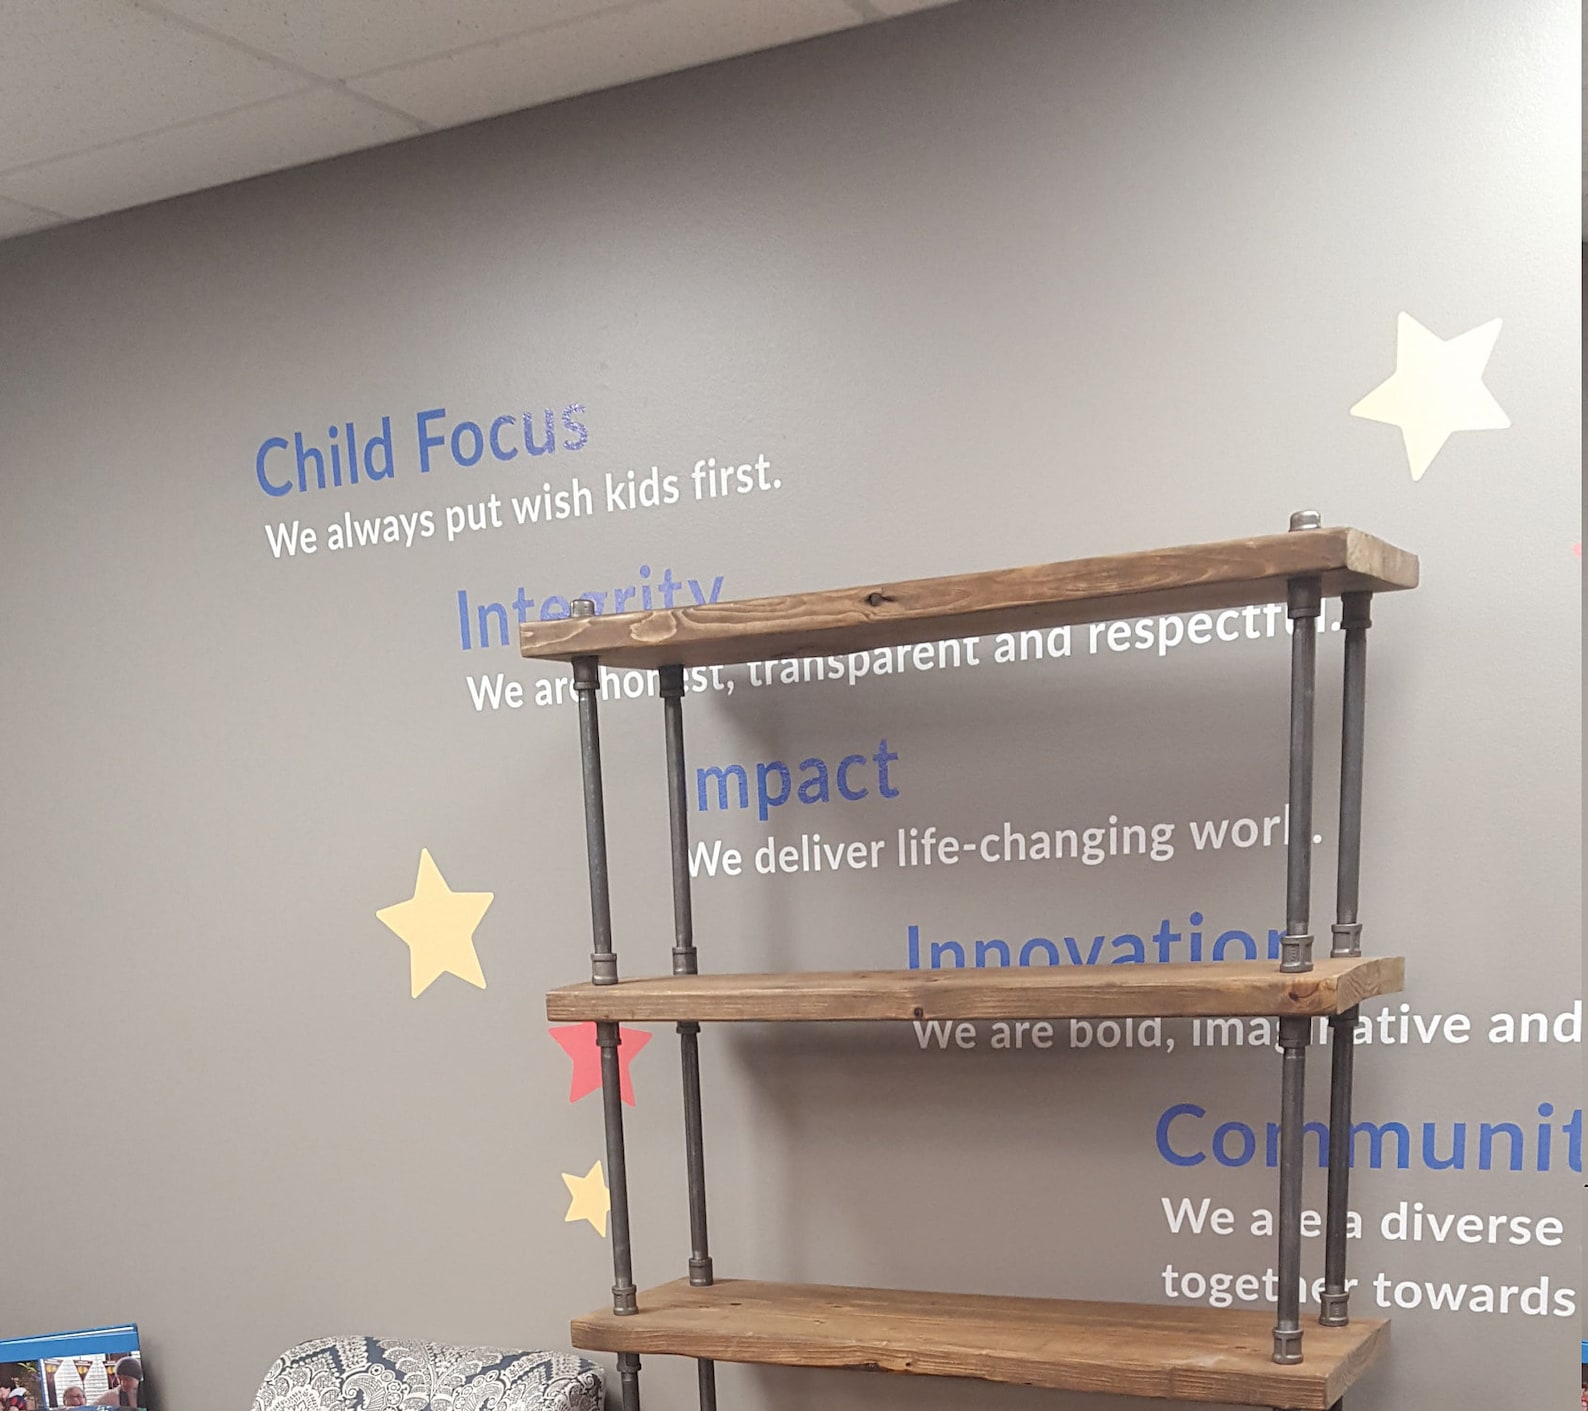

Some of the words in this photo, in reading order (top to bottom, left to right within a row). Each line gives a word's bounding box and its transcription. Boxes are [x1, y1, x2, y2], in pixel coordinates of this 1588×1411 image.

[257, 417, 394, 496] Child
[416, 403, 588, 473] Focus
[265, 521, 317, 557] We
[328, 511, 434, 550] always
[446, 494, 502, 541] put
[512, 478, 592, 524] wish
[606, 467, 679, 511] kids
[692, 454, 781, 499] first.
[466, 674, 523, 711] We
[747, 637, 980, 686] transparent
[994, 625, 1072, 662] and
[1088, 597, 1342, 656] respectfl.
[696, 738, 899, 821] mpact
[689, 840, 742, 877] We
[755, 834, 885, 873] deliver
[898, 815, 1175, 866] life-changing
[913, 1021, 976, 1048] We
[992, 1022, 1053, 1048] are
[1070, 1018, 1174, 1053] bold,
[1489, 1000, 1582, 1043] and
[1155, 1103, 1582, 1172] Communit
[1161, 1198, 1234, 1234] We
[1251, 1209, 1321, 1237] ae
[1381, 1201, 1563, 1246] diverse
[1373, 1273, 1575, 1316] towards
